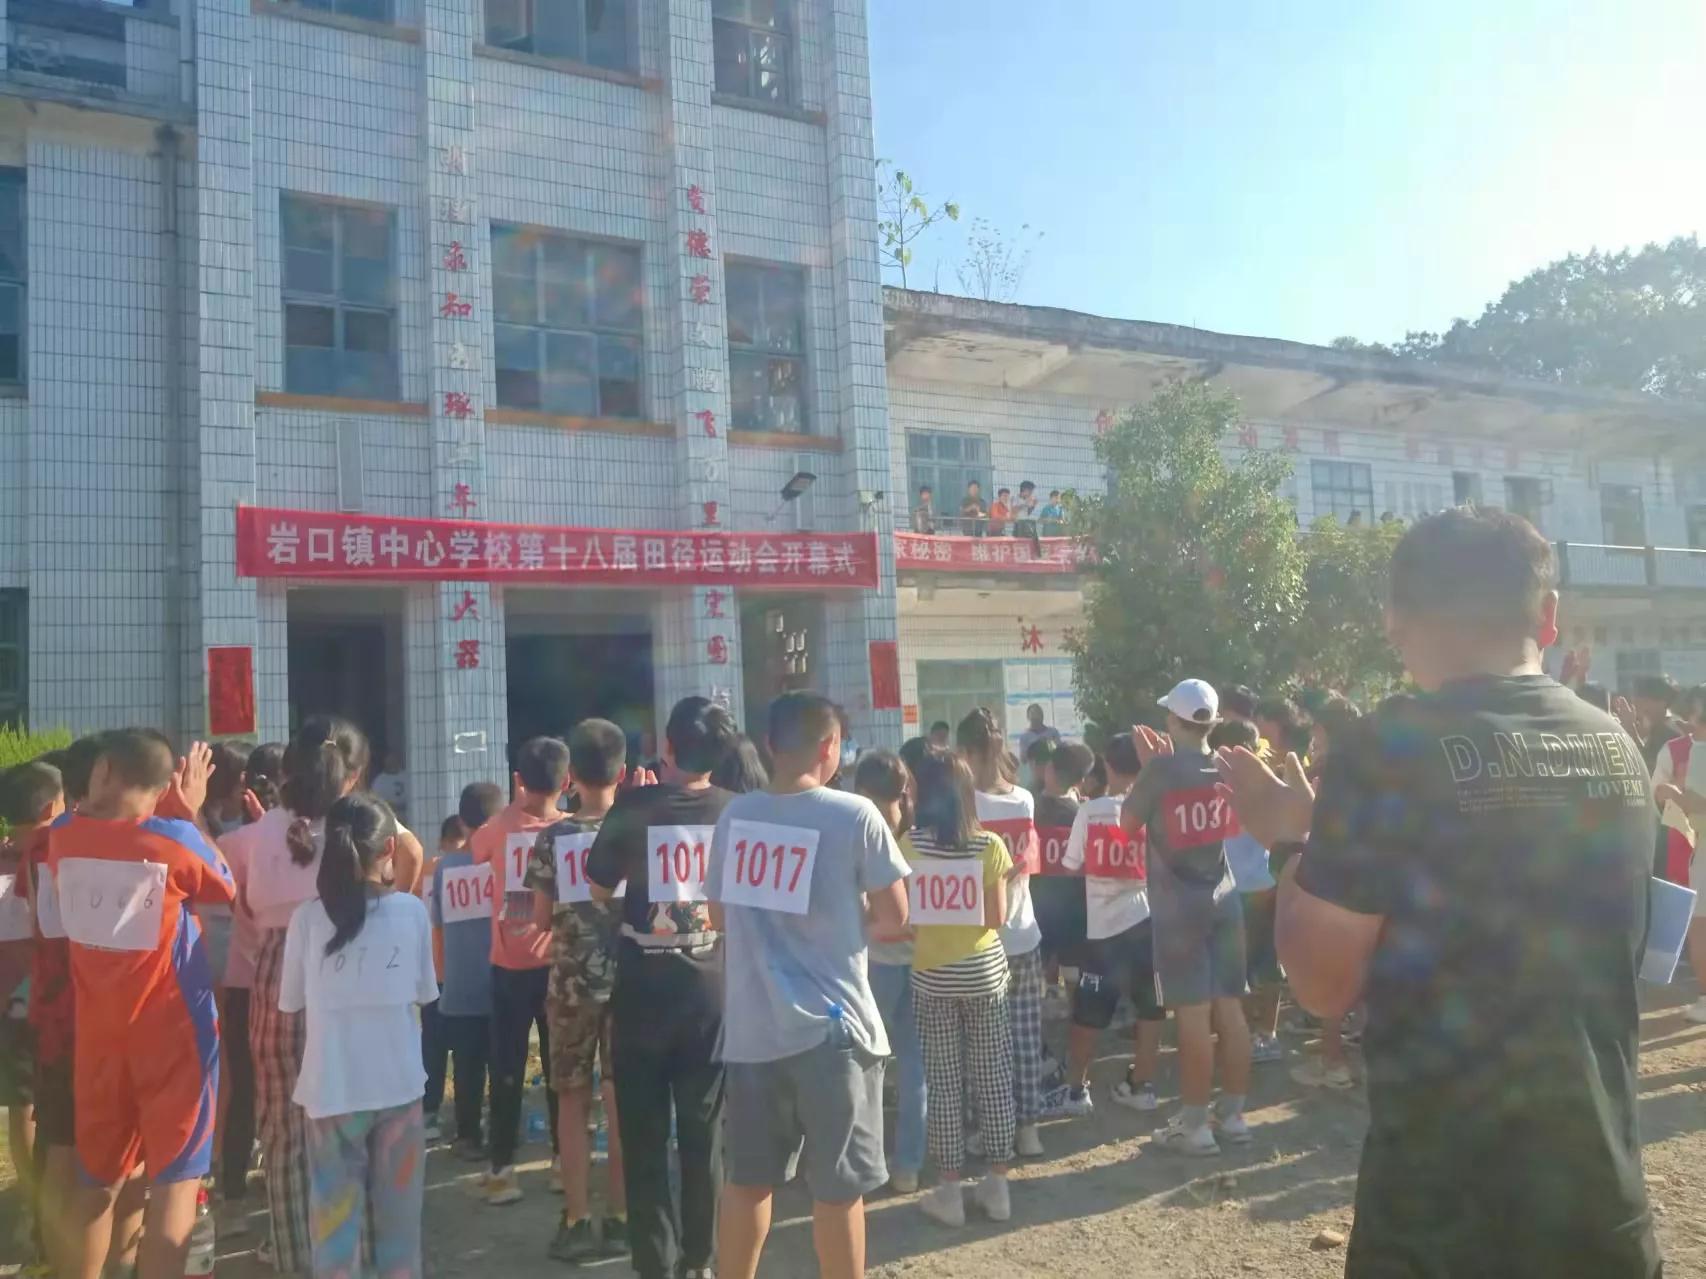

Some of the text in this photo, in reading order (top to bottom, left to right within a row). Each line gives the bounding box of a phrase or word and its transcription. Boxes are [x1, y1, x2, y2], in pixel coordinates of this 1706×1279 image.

[266, 520, 858, 578] 岩口镇中心学校第十八届田径运动会开幕式
[735, 838, 808, 893] 1017
[446, 874, 494, 910] 1014
[915, 874, 978, 911] 1020
